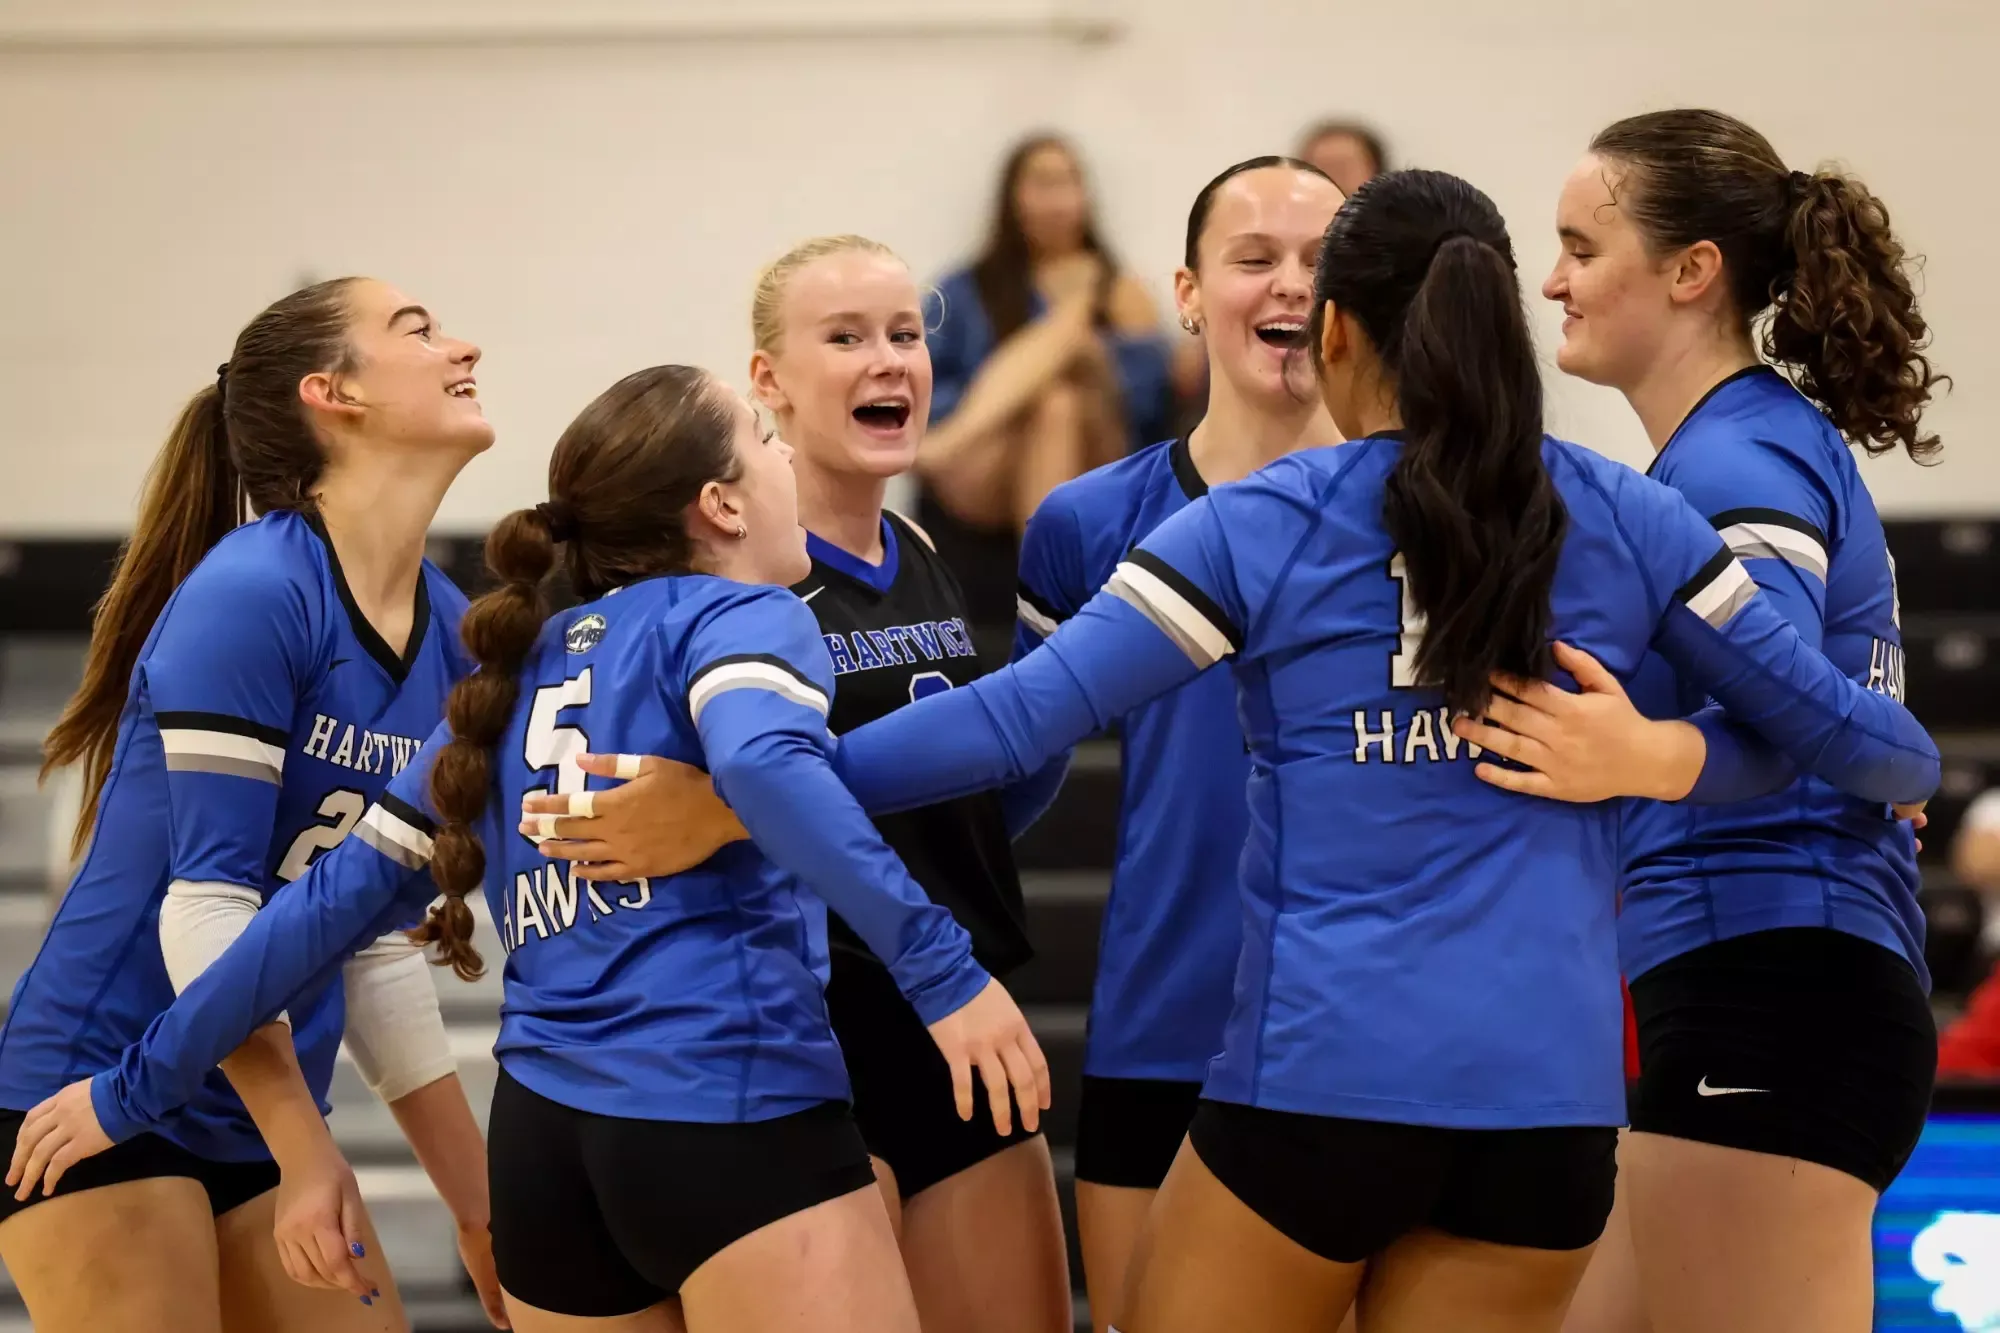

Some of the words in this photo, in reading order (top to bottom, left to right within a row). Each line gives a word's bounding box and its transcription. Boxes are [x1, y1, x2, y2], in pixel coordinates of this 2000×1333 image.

[525, 666, 593, 846] 5
[1353, 706, 1483, 764] HAW
[276, 789, 365, 882] 2
